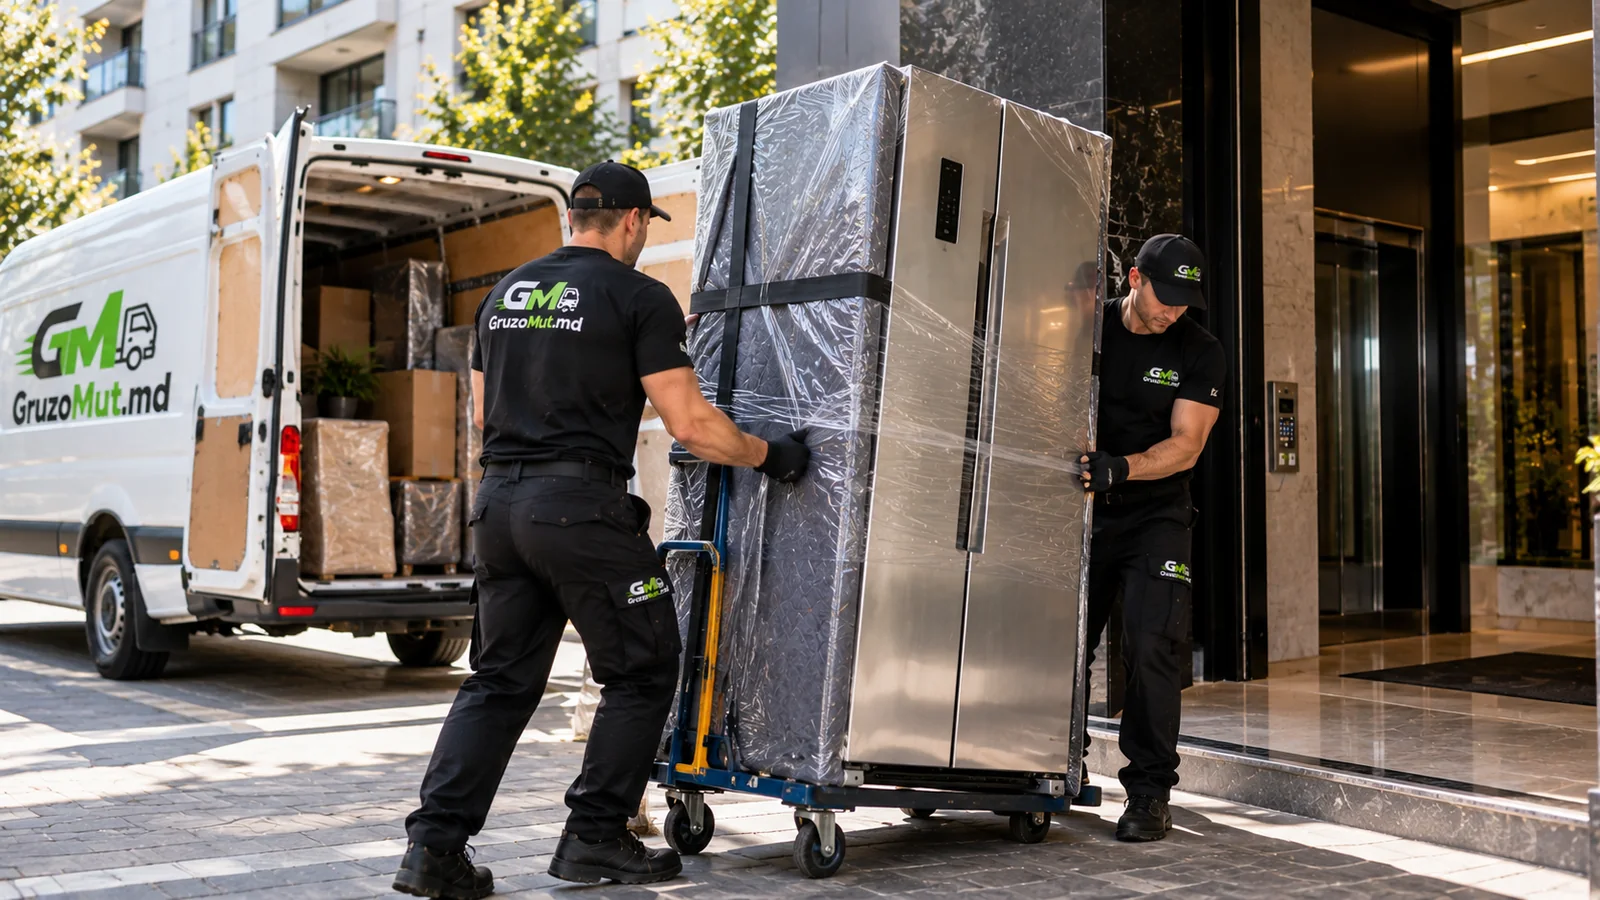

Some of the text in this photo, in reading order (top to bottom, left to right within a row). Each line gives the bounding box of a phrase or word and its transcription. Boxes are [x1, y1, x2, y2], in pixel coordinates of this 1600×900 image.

[503, 280, 568, 310] GM
[32, 289, 124, 379] GM
[488, 315, 584, 332] GruzoMut.md
[13, 371, 172, 425] GruzoMut.md
